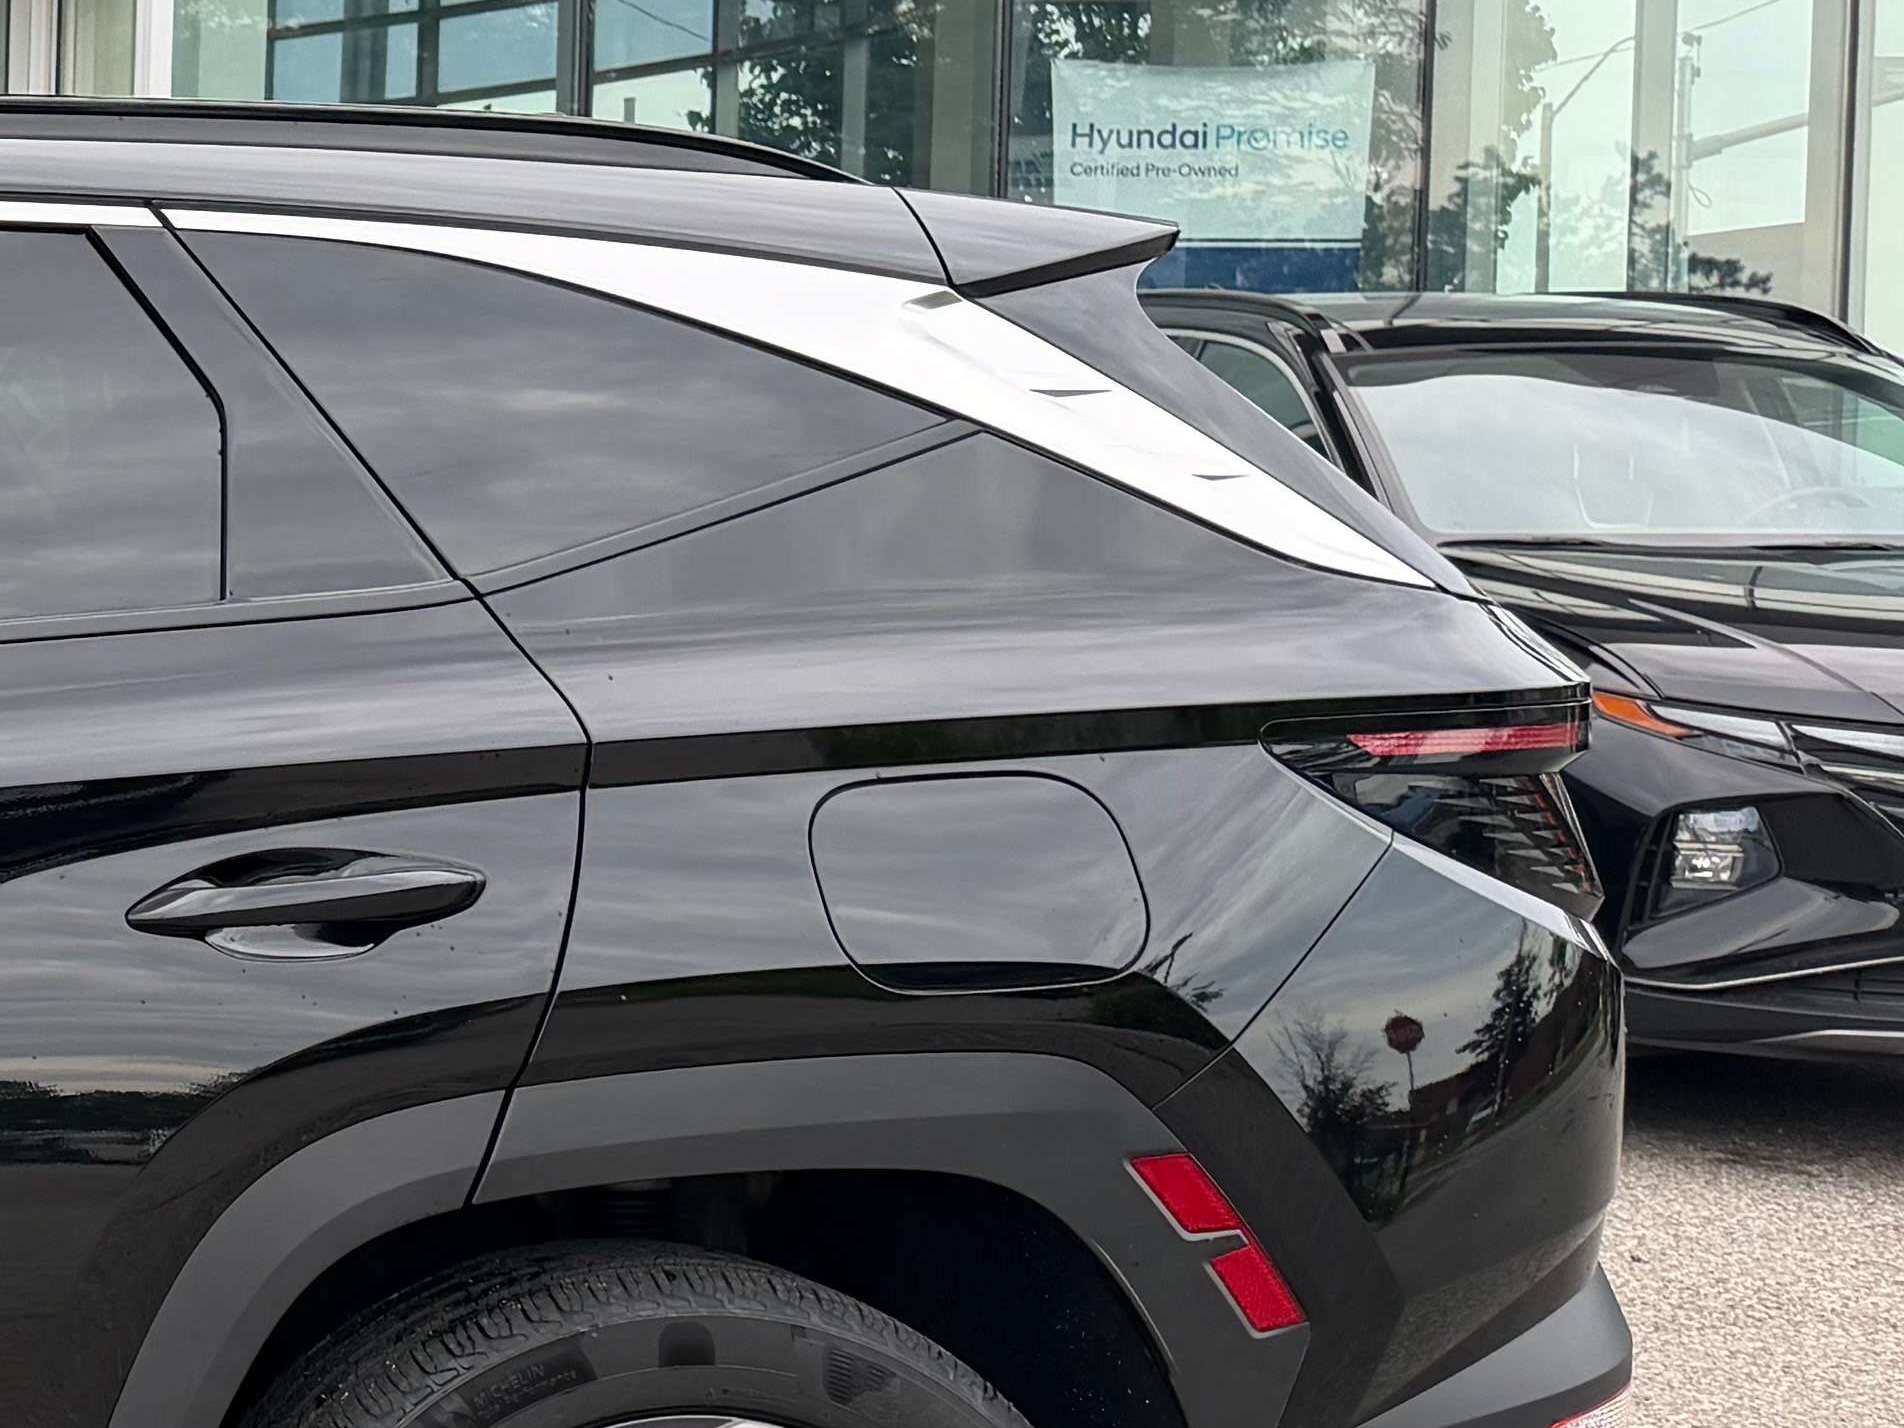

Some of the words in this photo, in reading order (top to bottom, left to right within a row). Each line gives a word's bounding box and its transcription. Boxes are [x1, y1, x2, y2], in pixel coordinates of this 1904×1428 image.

[1070, 121, 1209, 156] Hyundai
[1214, 122, 1349, 151] Promise
[1069, 161, 1141, 179] Certified
[1144, 162, 1239, 179] Pre-Owned
[473, 1364, 545, 1410] MICHELIN
